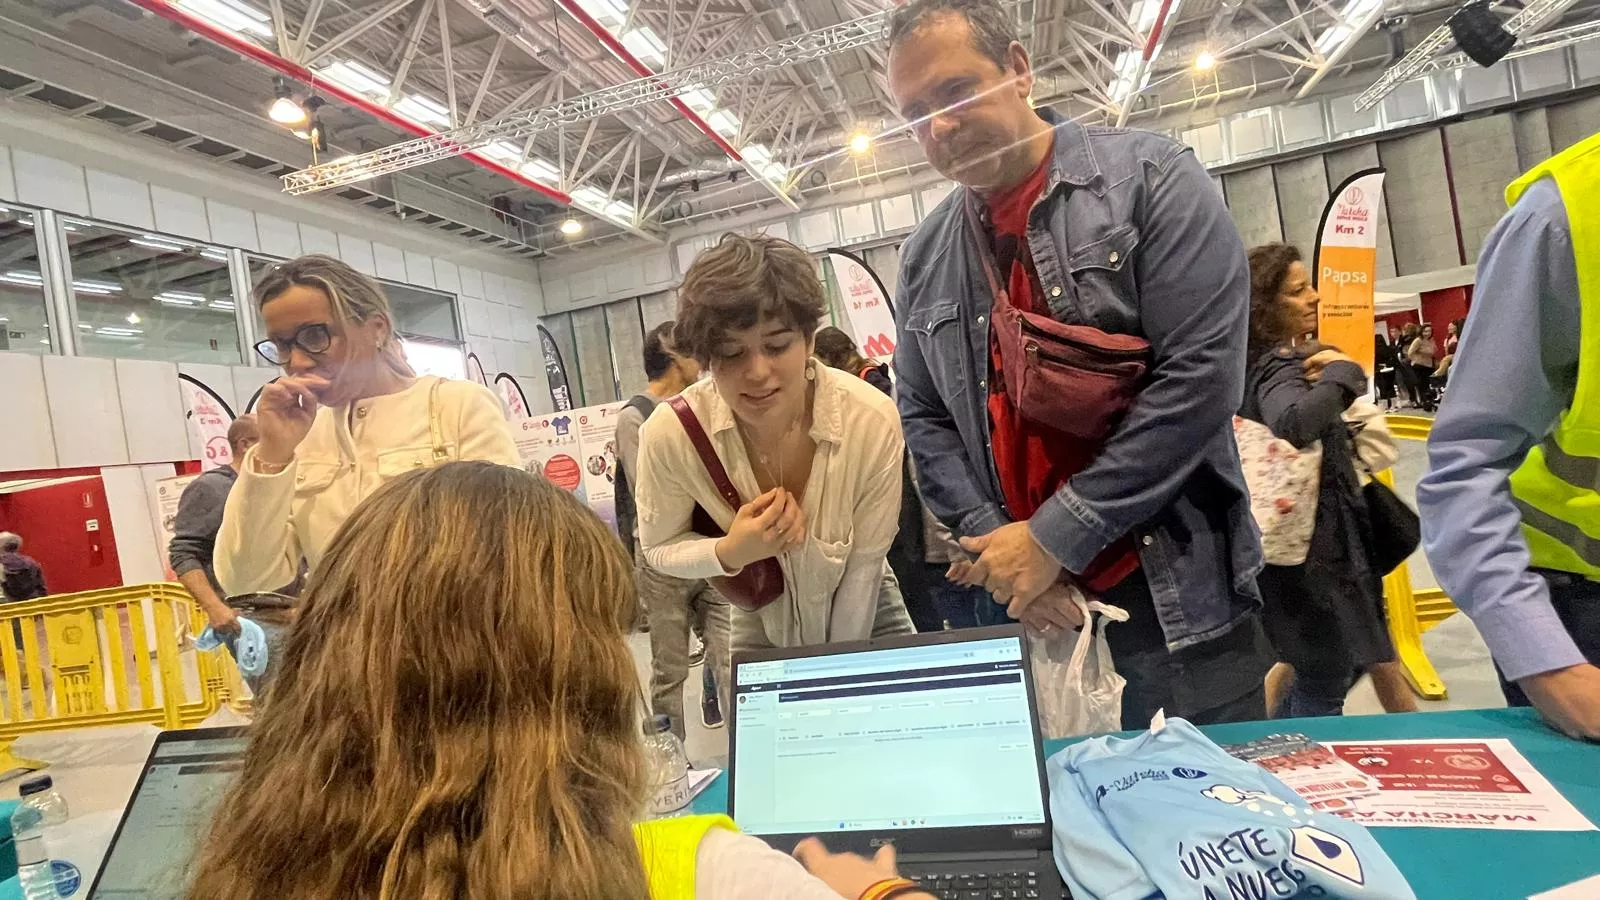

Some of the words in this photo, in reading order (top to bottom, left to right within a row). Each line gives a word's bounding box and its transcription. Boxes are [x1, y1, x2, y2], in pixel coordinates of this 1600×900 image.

[1335, 223, 1355, 234] Km
[1357, 225, 1365, 235] 2
[1322, 266, 1368, 288] Papsa
[600, 408, 607, 418] 7
[522, 422, 529, 431] 6
[652, 789, 689, 808] VERI
[1329, 811, 1377, 819] AS
[1384, 811, 1537, 822] MARCHA
[1178, 827, 1277, 881] ÚNETE
